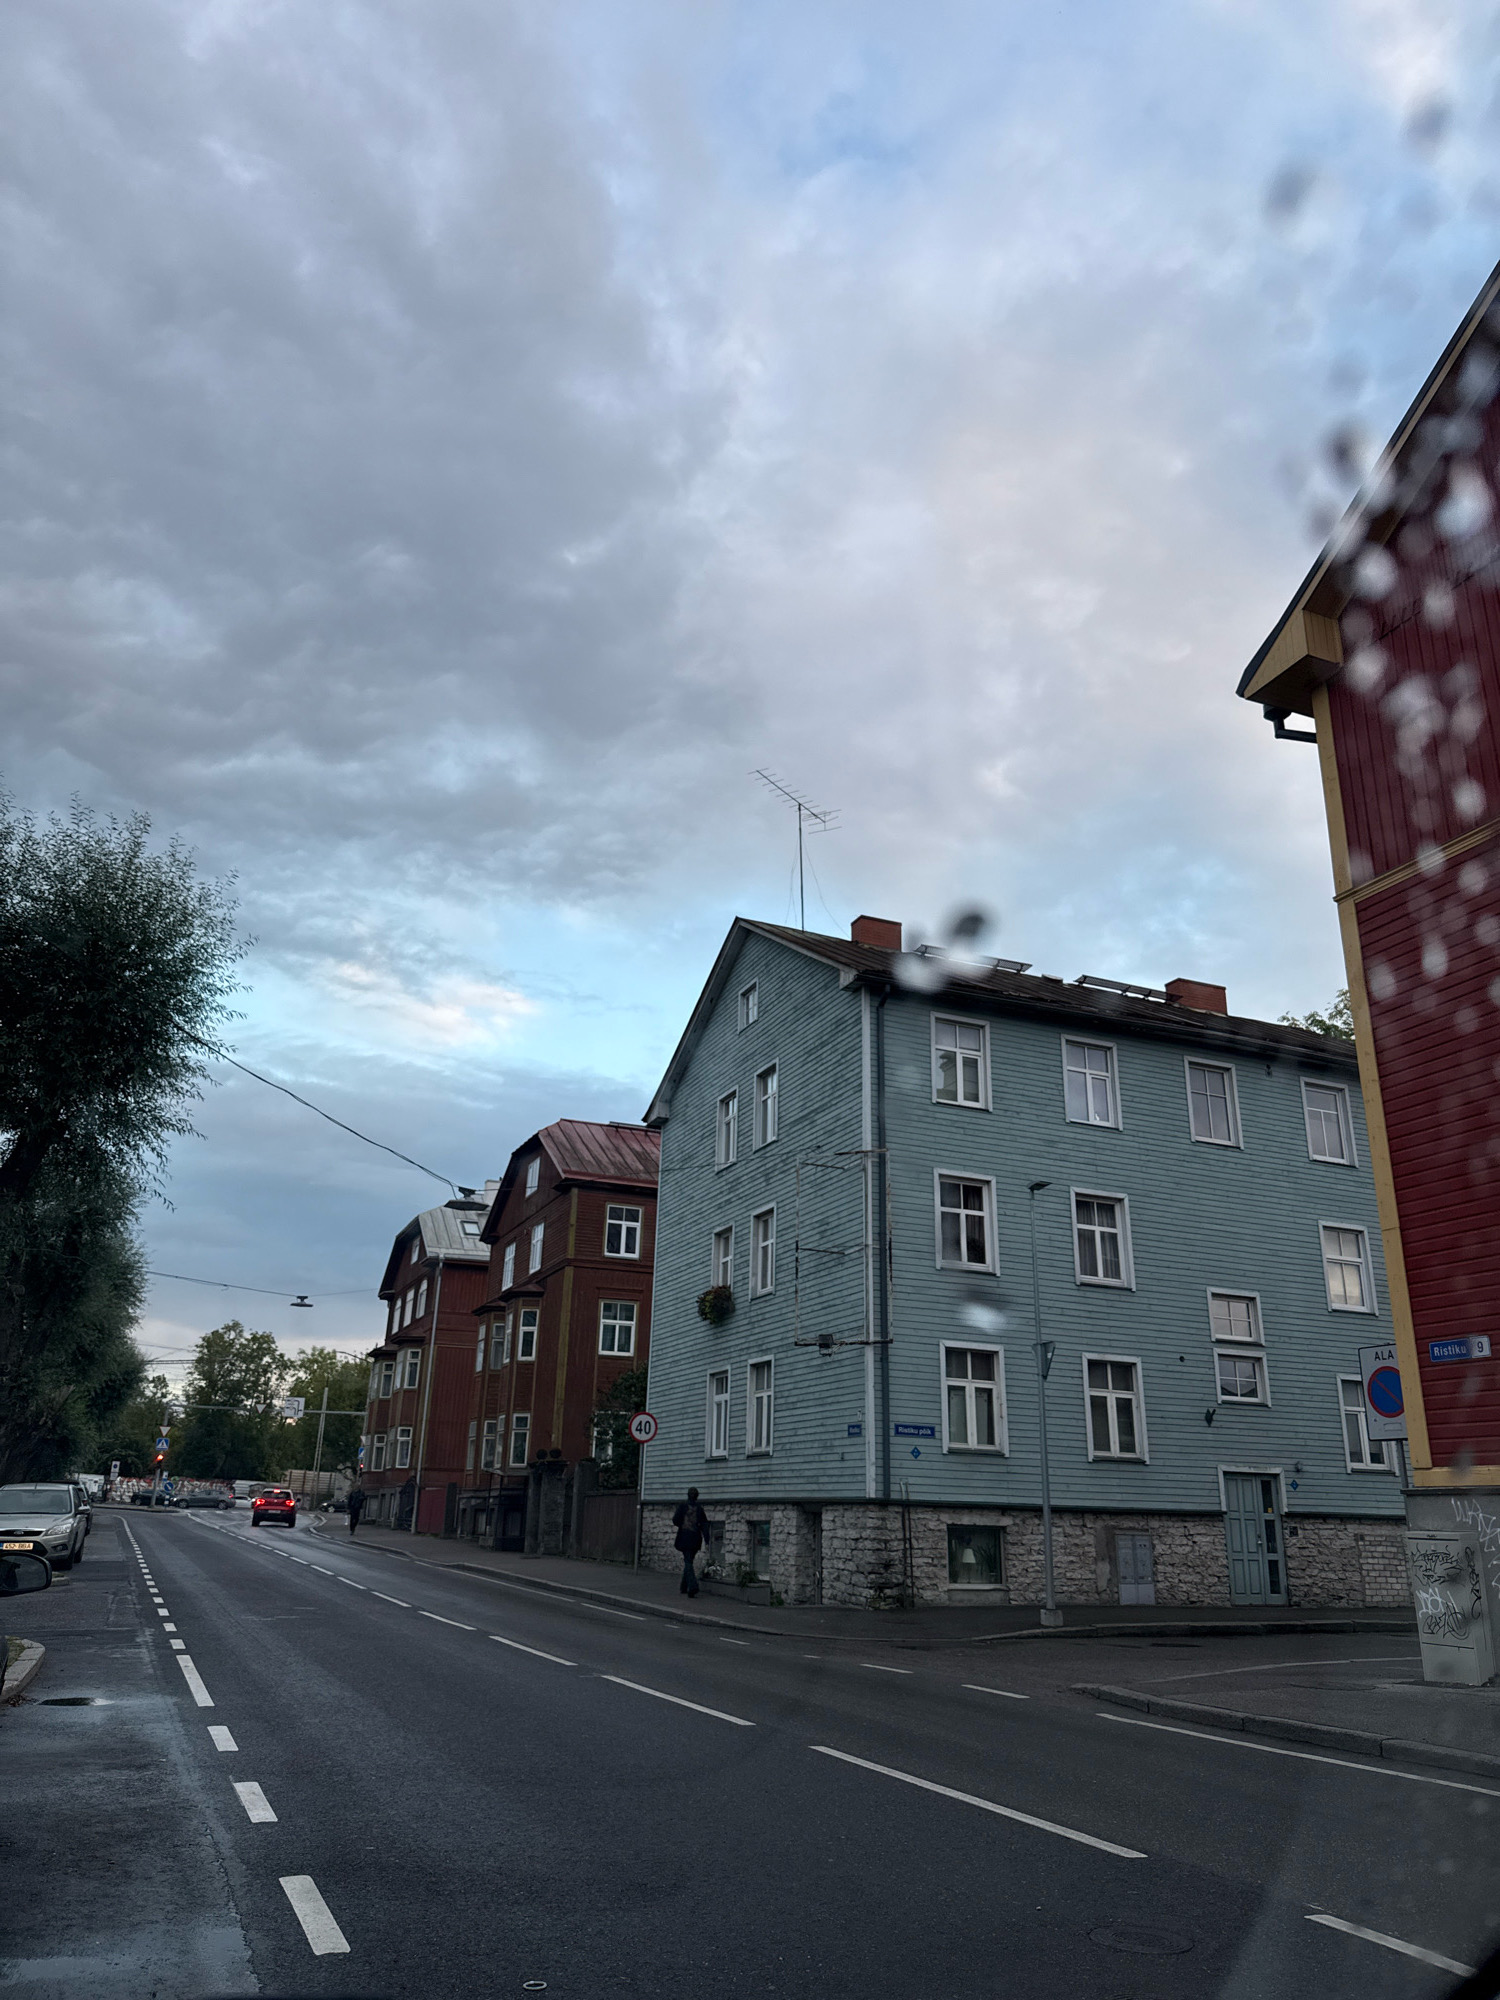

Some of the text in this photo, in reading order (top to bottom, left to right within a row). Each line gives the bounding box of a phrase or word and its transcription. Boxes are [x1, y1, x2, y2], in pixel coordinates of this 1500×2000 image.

[1374, 1349, 1395, 1361] ALA
[1433, 1341, 1484, 1357] Ristiku 9
[635, 1420, 651, 1435] 40
[898, 1426, 918, 1434] Ristiku
